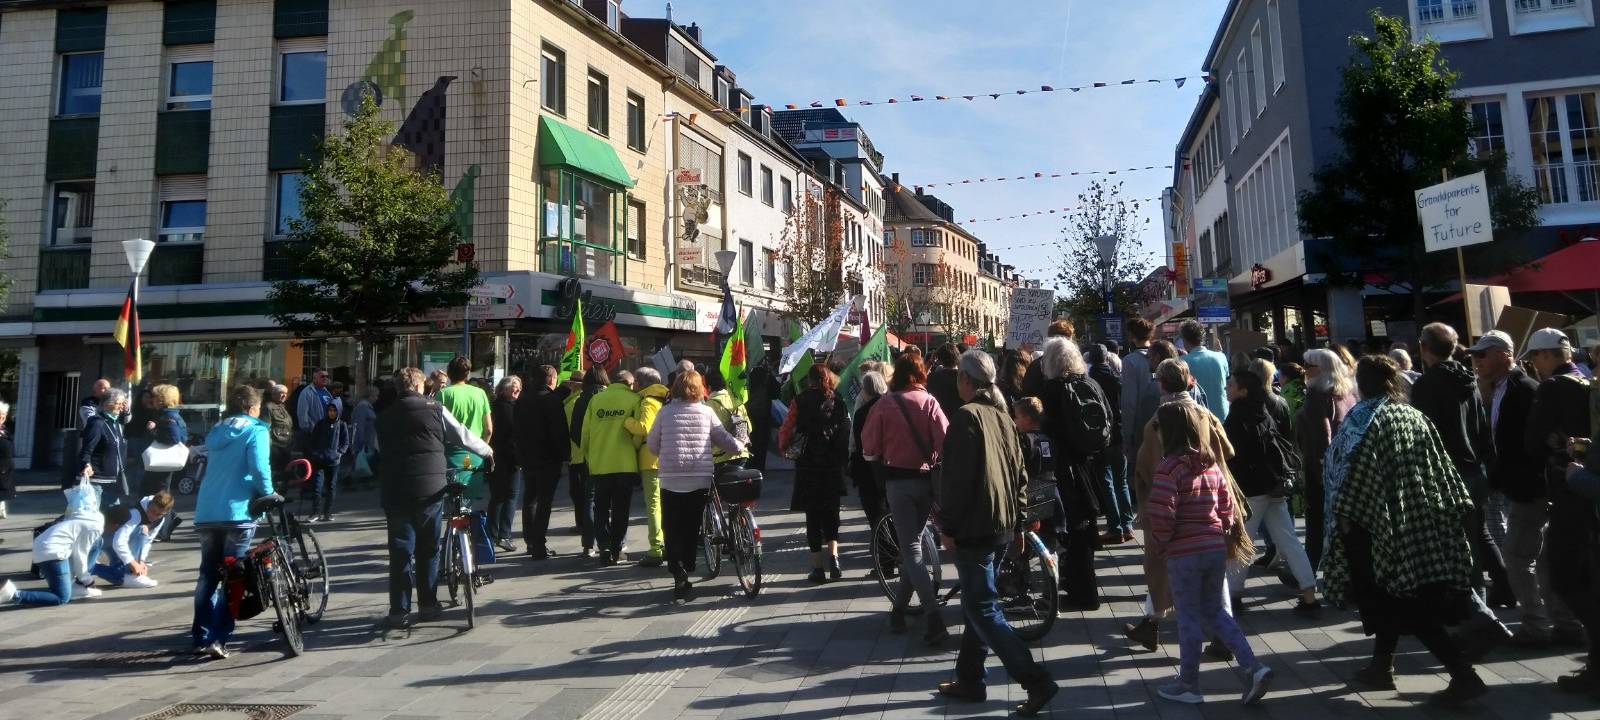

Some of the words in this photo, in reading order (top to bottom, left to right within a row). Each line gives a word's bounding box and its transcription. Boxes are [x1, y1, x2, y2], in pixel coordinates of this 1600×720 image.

[1444, 203, 1462, 219] for
[1430, 221, 1482, 243] Future
[605, 409, 625, 417] BUND
